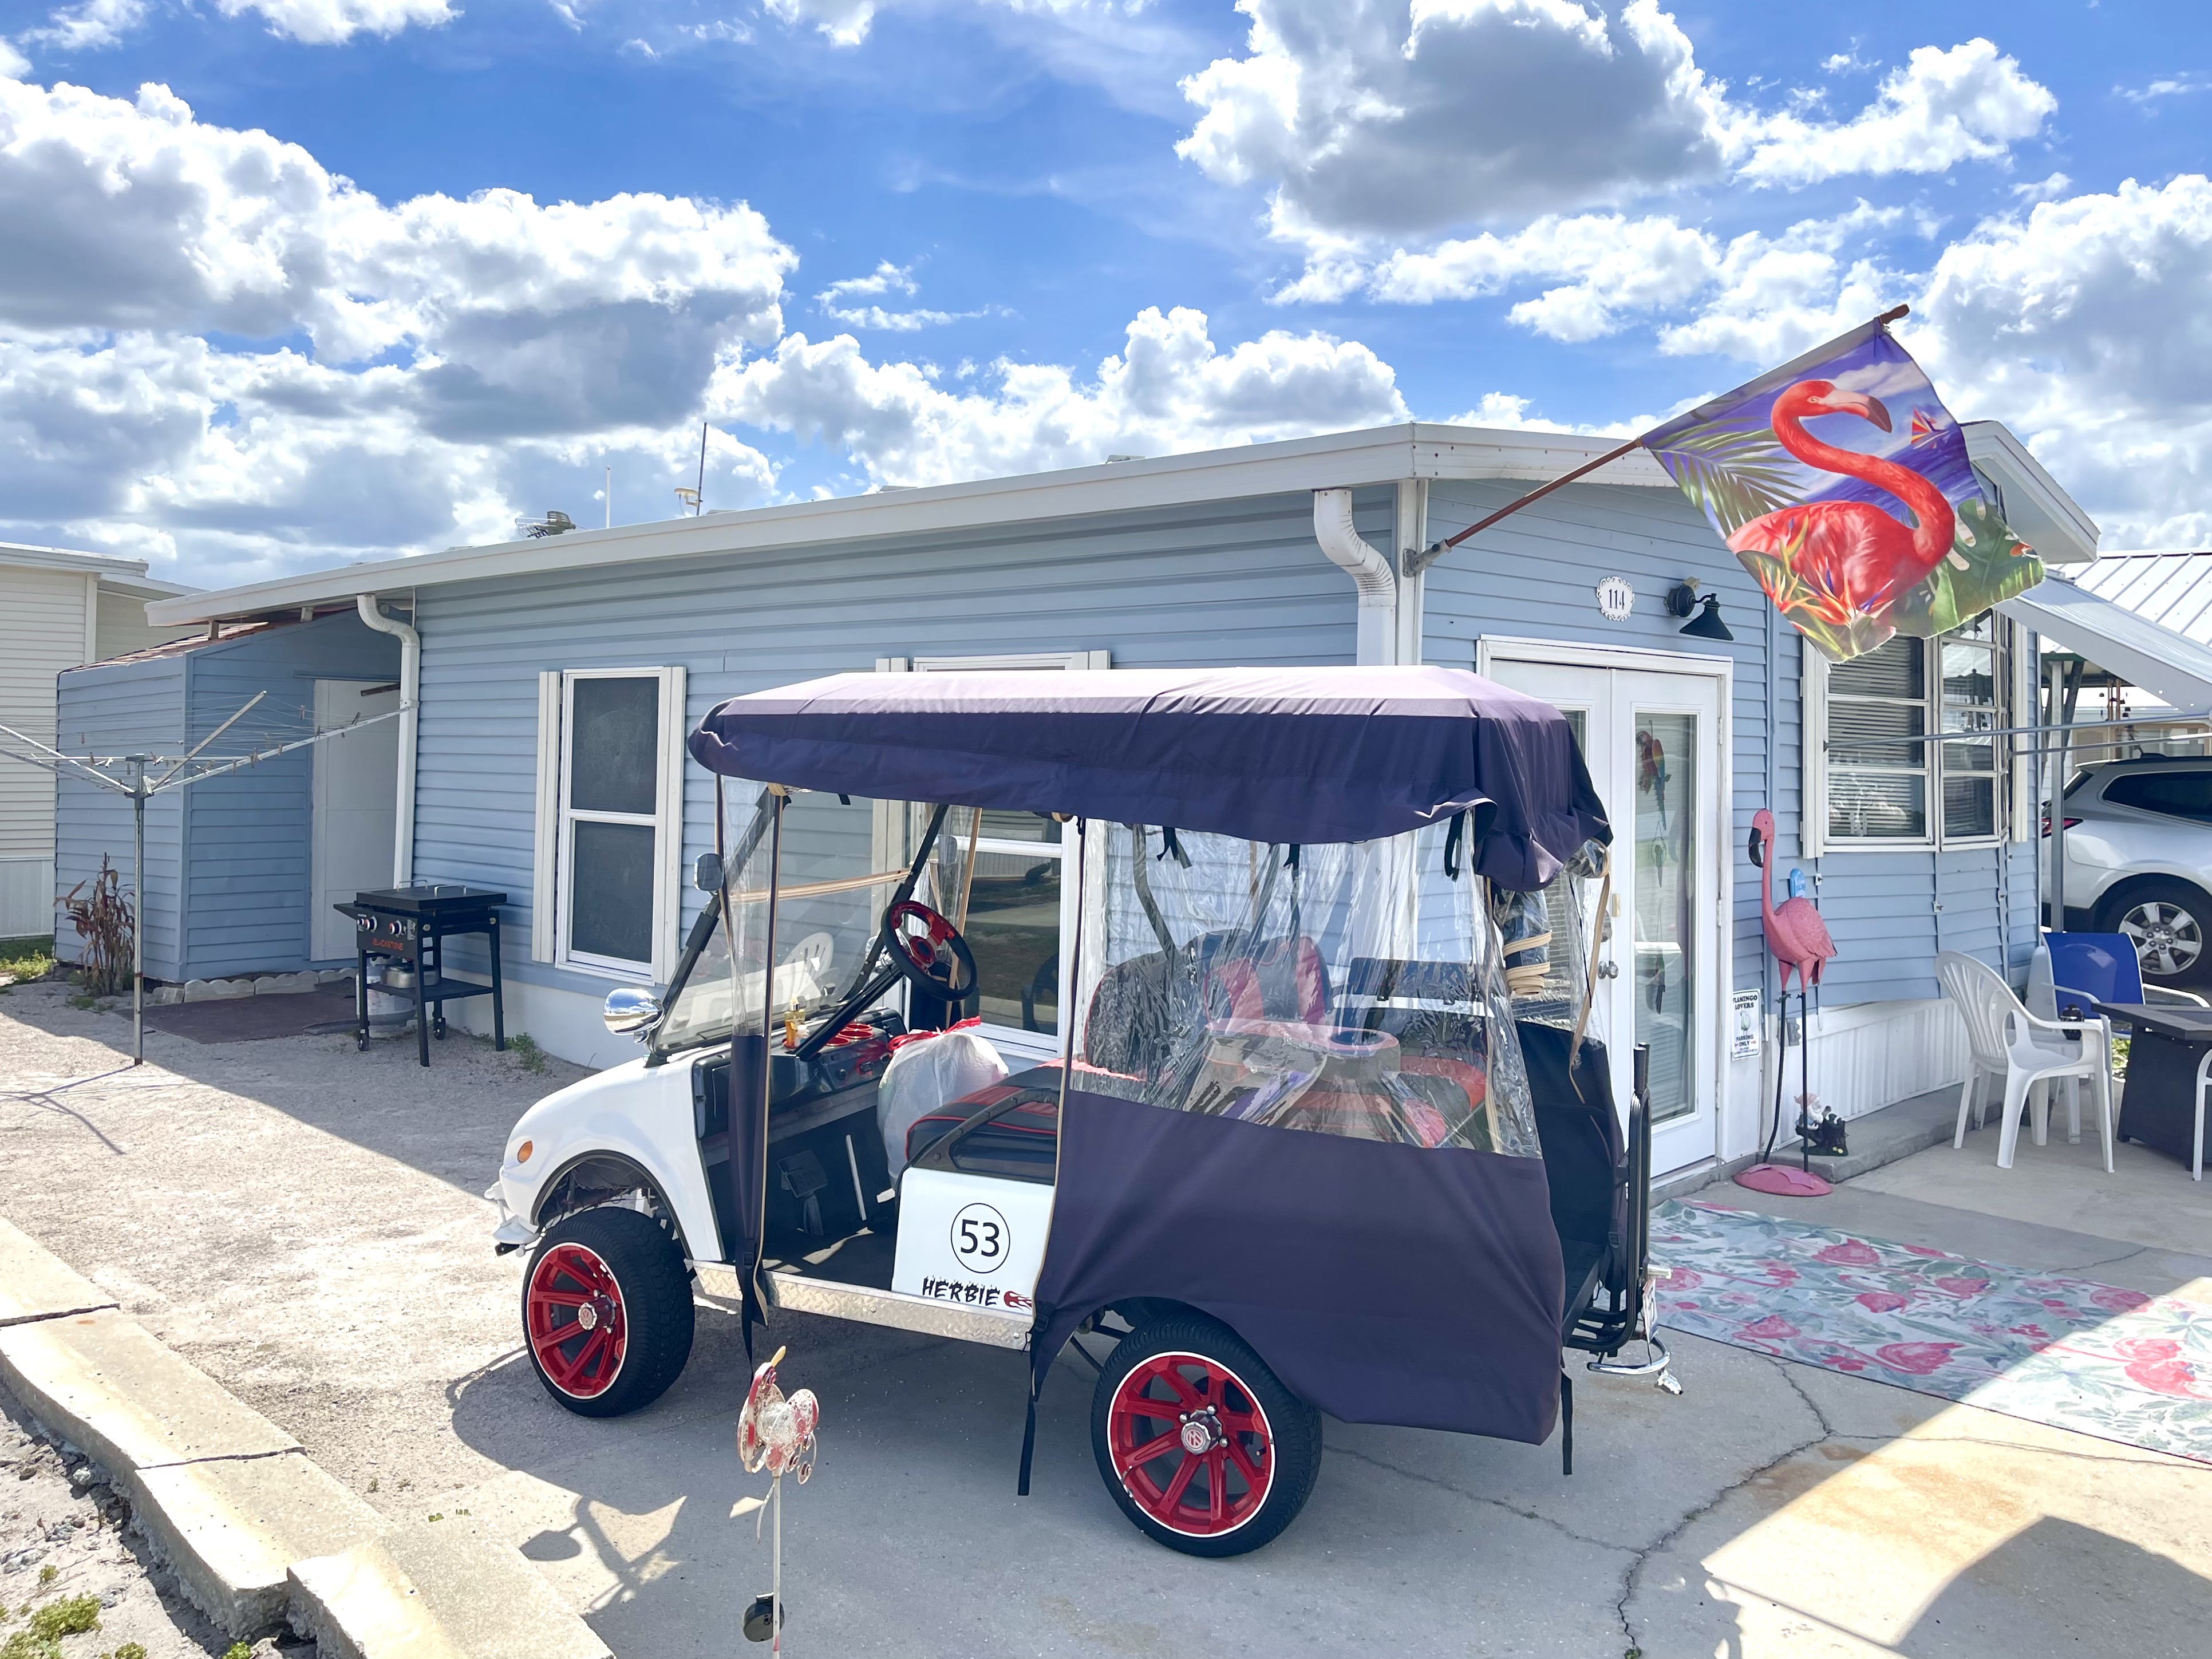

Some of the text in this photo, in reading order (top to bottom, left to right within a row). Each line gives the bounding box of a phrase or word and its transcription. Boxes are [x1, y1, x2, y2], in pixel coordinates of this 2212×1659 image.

[1608, 588, 1625, 610] 114
[1733, 995, 1757, 1003] FLAMINGO
[960, 1219, 1000, 1257] 53
[922, 1275, 1001, 1306] HERBIE
